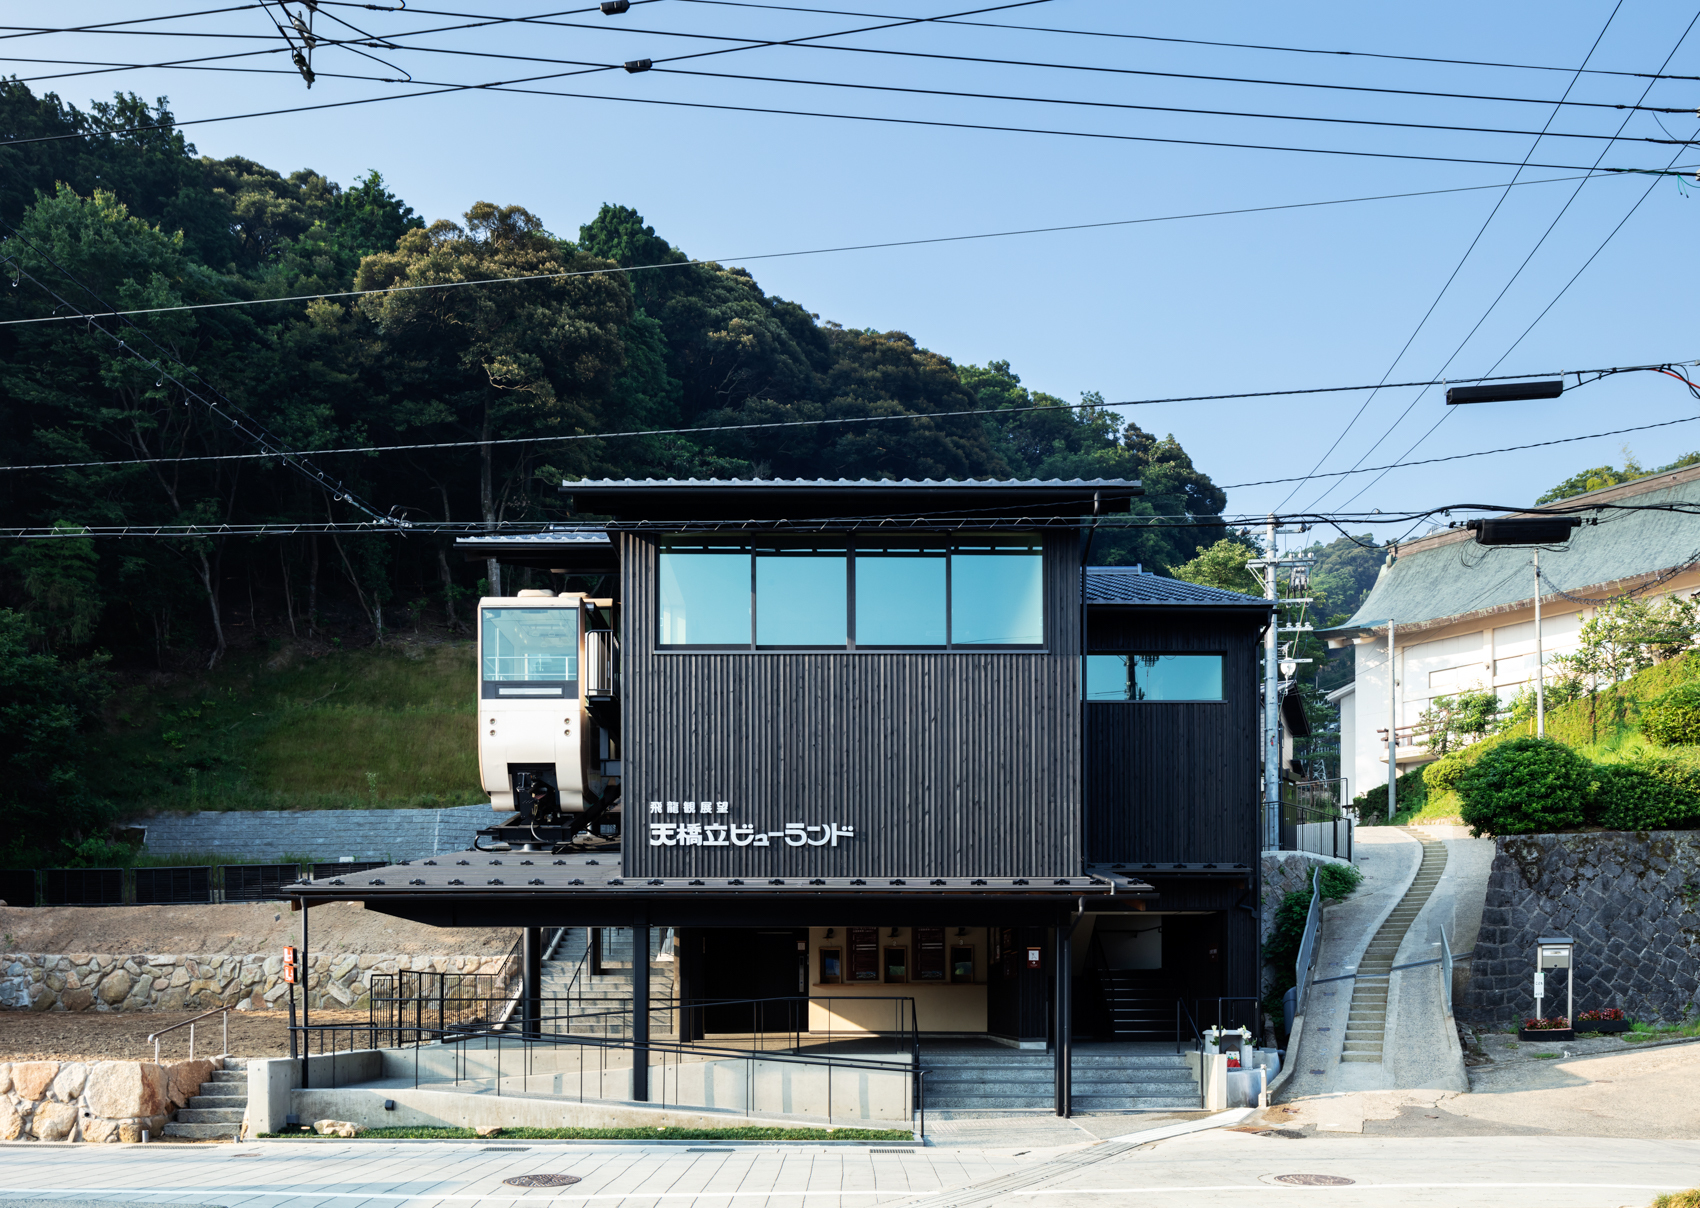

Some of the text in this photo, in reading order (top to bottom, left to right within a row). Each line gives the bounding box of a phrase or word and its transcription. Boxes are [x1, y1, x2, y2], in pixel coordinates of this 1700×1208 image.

[650, 801, 729, 814] 飛龍観展望
[650, 823, 854, 847] 天橋立ビューランド
